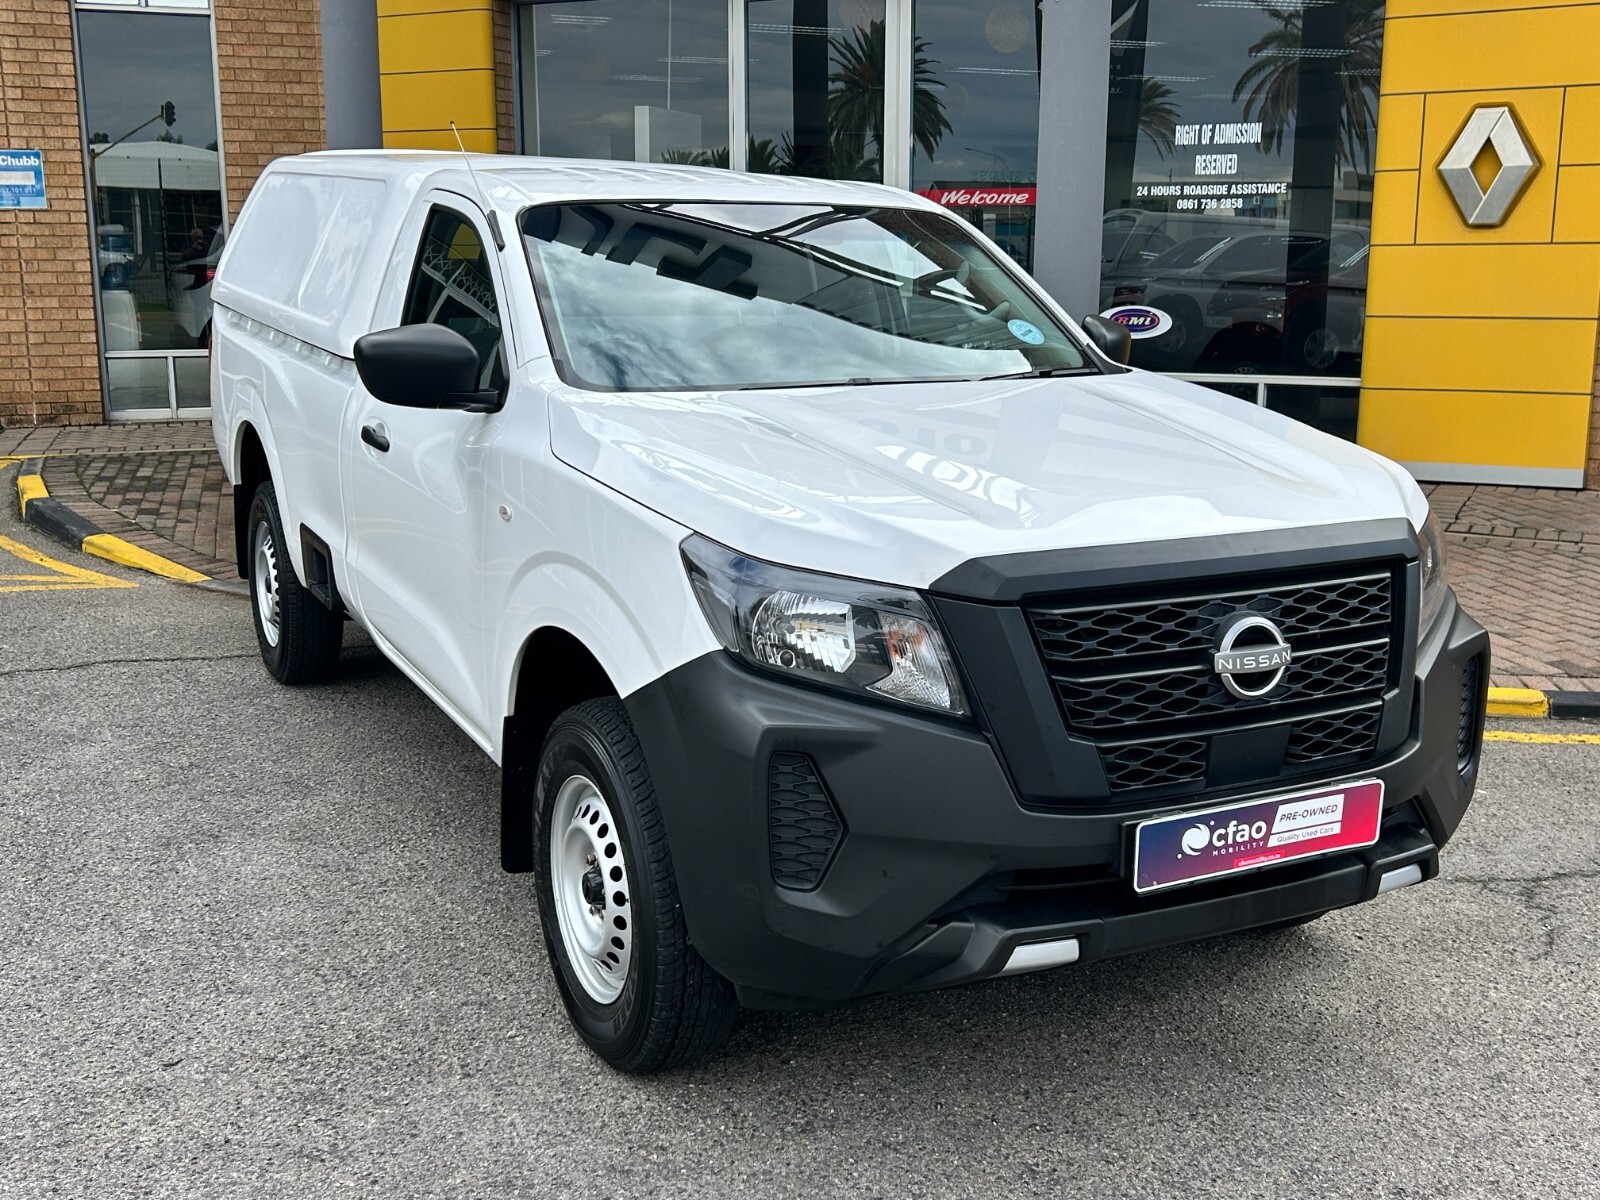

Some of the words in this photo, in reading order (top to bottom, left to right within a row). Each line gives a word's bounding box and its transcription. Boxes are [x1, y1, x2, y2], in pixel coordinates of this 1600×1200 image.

[1175, 124, 1200, 146] RIGHT
[1201, 124, 1213, 145] OF
[1213, 122, 1262, 145] ADMISSION
[0, 155, 39, 166] Chubb
[1195, 153, 1238, 175] RESERVED
[940, 190, 1029, 204] Welcome
[1136, 186, 1148, 196] 24
[1150, 185, 1181, 196] HOURS
[1183, 184, 1228, 195] ROADSIDE
[1230, 183, 1287, 195] ASSISTANCE
[1176, 199, 1198, 210] 0861
[1200, 199, 1217, 209] 736
[1220, 198, 1243, 209] 2858
[1218, 649, 1291, 670] NISSAN
[1279, 804, 1338, 822] PRE-OWNED
[1212, 820, 1267, 847] cfao
[1277, 833, 1301, 843] Quality
[1301, 829, 1318, 838] Used
[1212, 840, 1264, 856] MOBILITY
